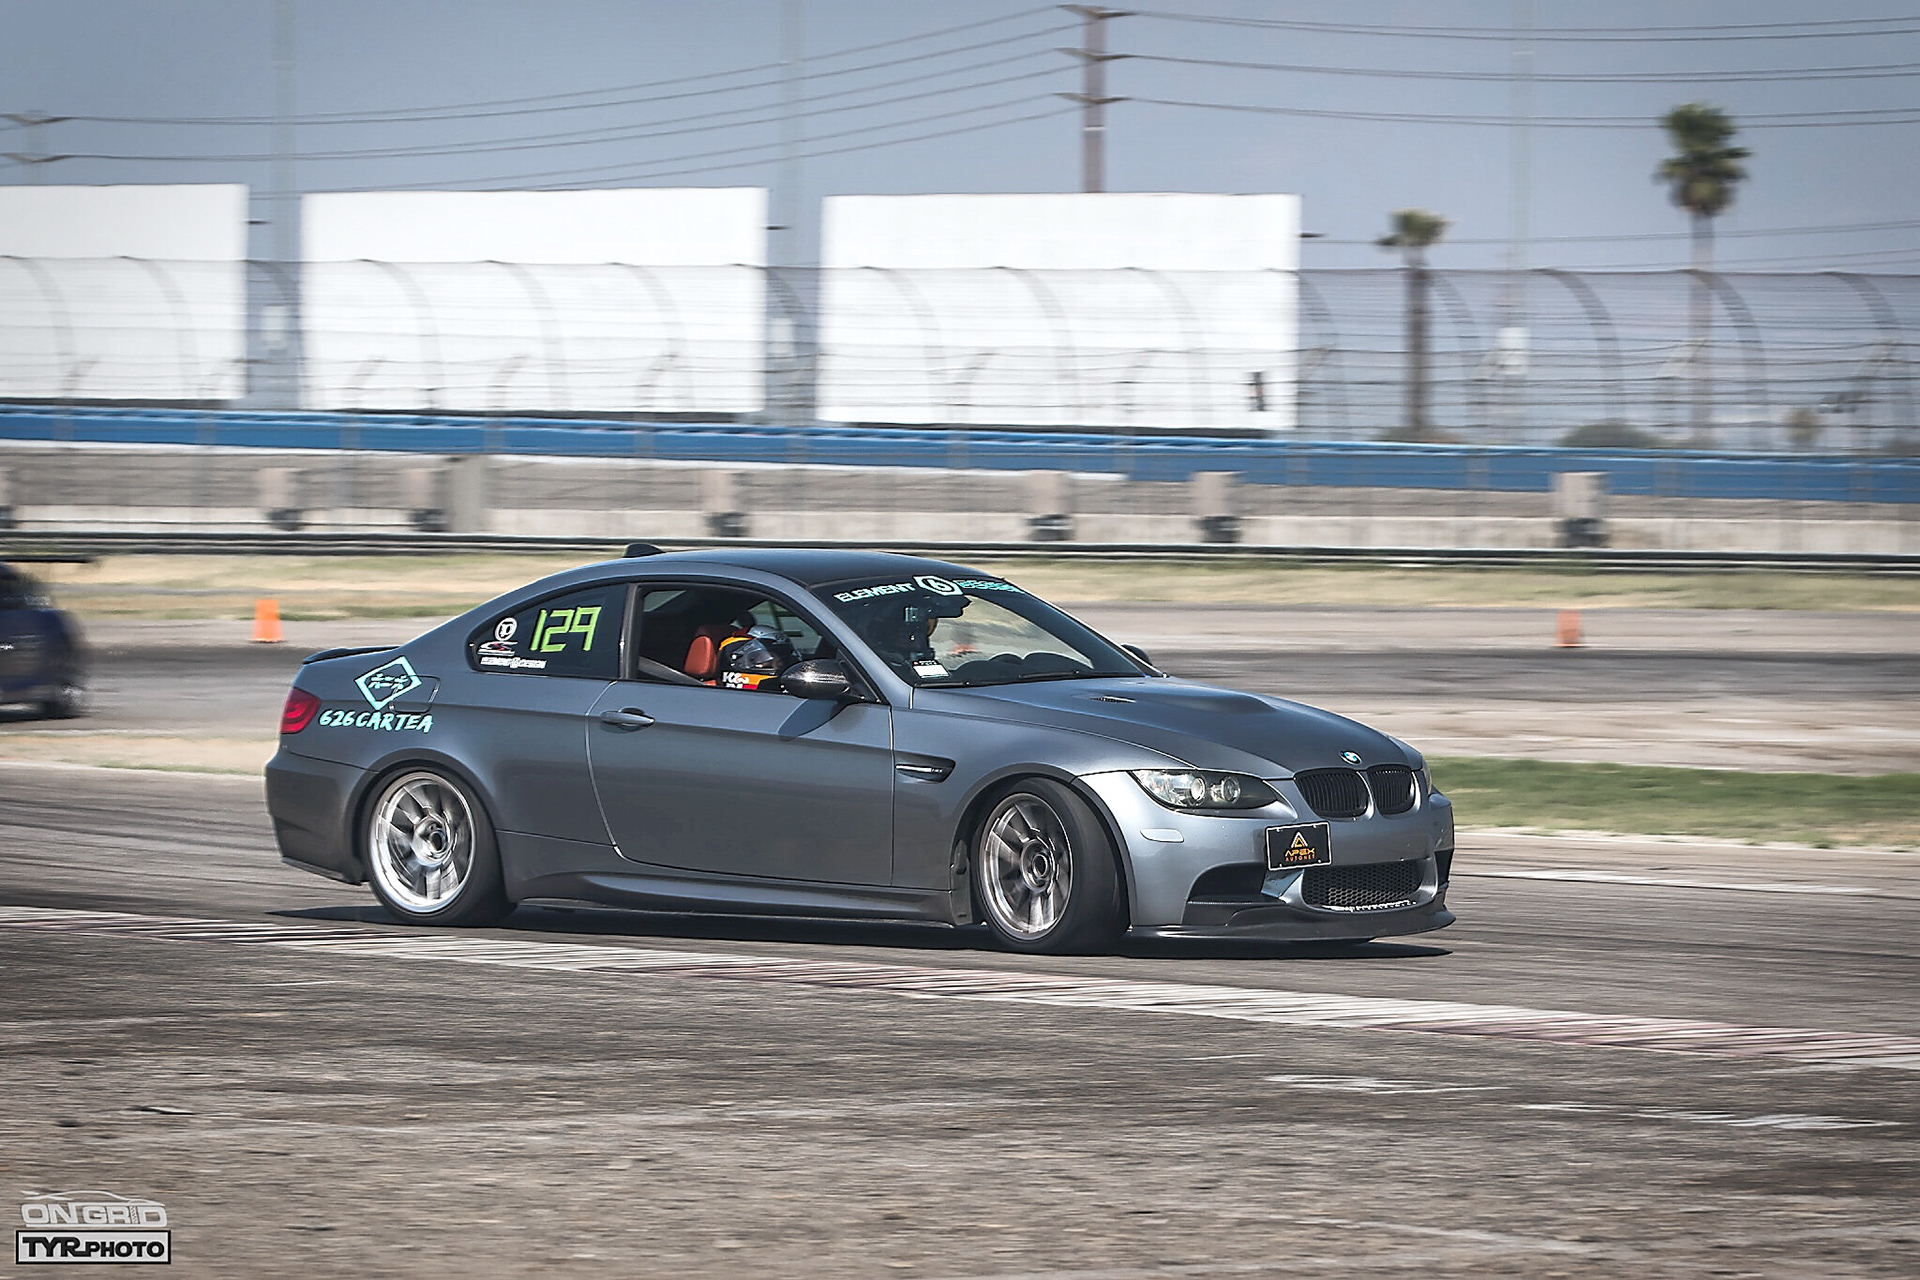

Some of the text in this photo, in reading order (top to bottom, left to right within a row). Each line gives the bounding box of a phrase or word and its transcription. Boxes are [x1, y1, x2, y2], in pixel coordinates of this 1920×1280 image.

[833, 583, 916, 602] ELEMENT
[530, 606, 602, 652] 129
[1284, 847, 1316, 857] APEX
